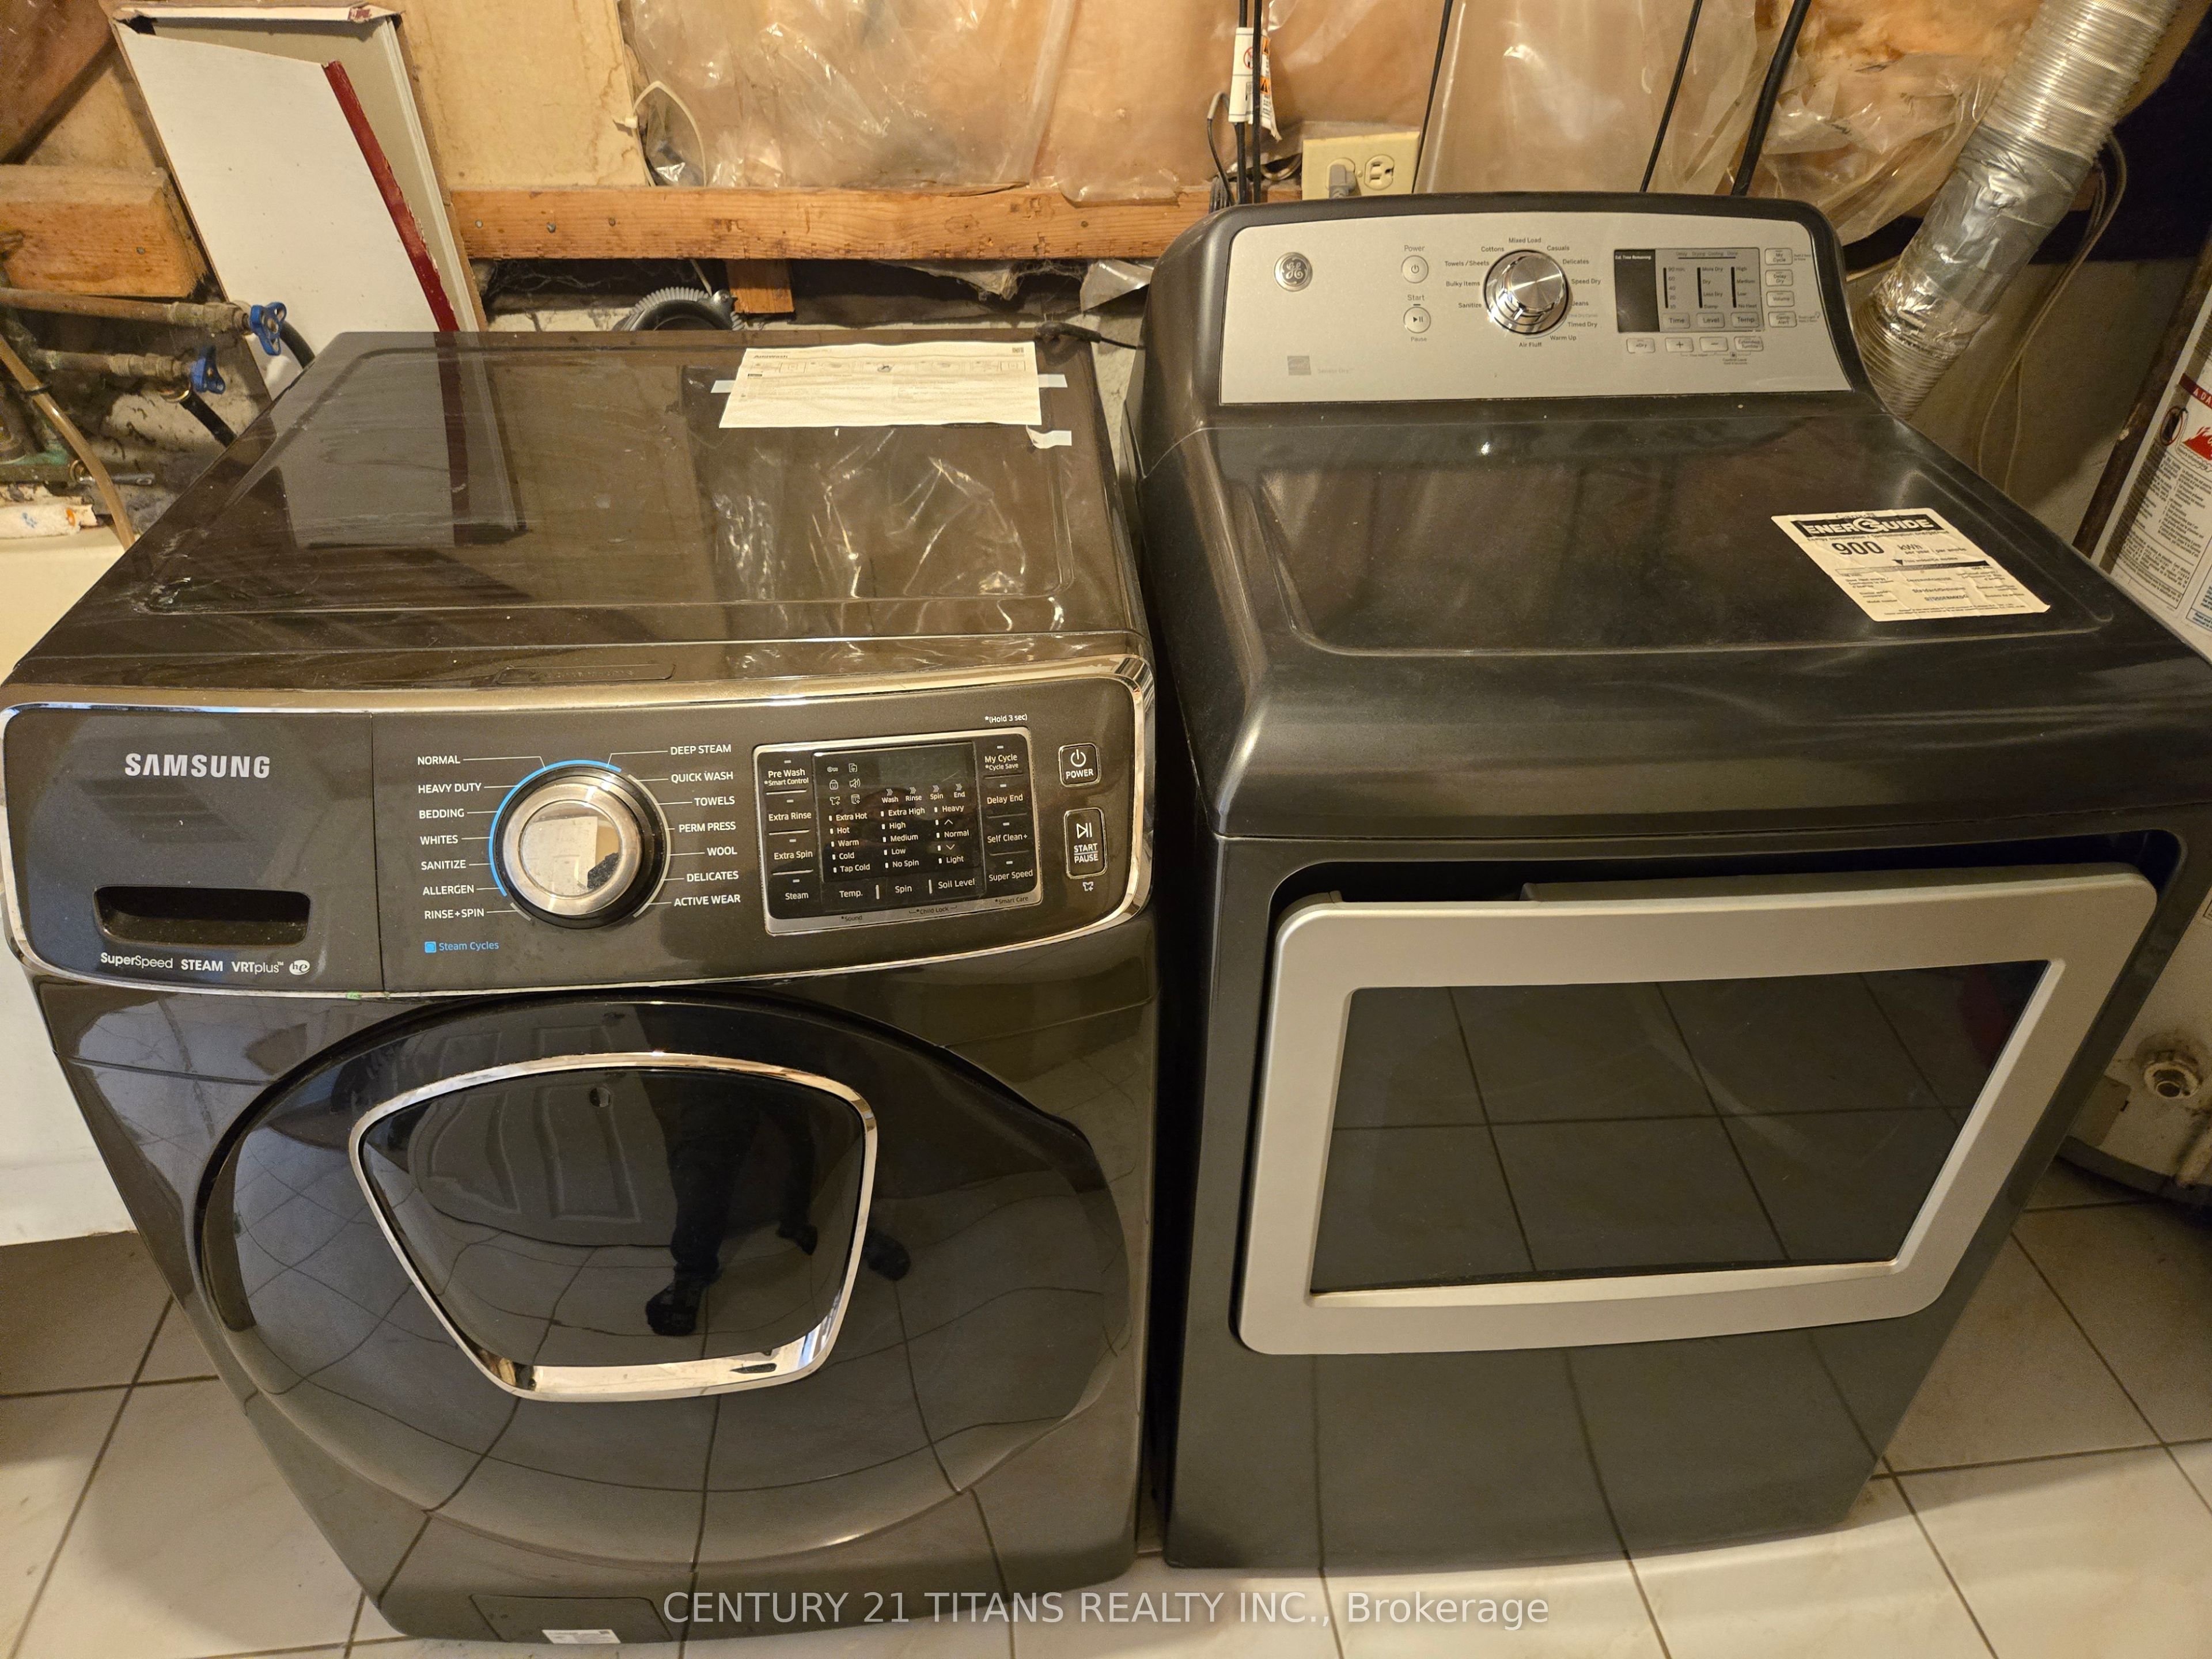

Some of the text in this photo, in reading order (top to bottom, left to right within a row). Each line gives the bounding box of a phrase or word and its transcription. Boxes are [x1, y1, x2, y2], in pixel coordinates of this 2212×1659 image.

[1804, 518, 1934, 533] ENERGUIDE
[1832, 541, 1884, 555] 900
[670, 744, 732, 756] DEEP STEAM
[417, 755, 460, 765] NORMAL
[985, 754, 1017, 764] My Cycle
[125, 753, 270, 778] SAMSUNG
[671, 771, 733, 783] QUICK WASH
[783, 768, 805, 777] Wash
[1066, 768, 1094, 779] POWER
[418, 782, 482, 794] HEAVY DUTY
[694, 796, 735, 806] TOWELS
[987, 794, 1023, 805] Delay End
[419, 809, 464, 819] BEDDING
[679, 821, 736, 832] PERM PRESS
[889, 822, 906, 830] High
[944, 830, 969, 838] Normal
[987, 835, 1001, 843] Self
[420, 835, 458, 845] WHITES
[707, 847, 737, 856] WOOL
[1074, 843, 1097, 853] START
[796, 850, 813, 859] Spin
[1074, 854, 1099, 863] PAUSE
[421, 860, 466, 870] SANITIZE
[686, 871, 739, 882] DELICATES
[989, 869, 1033, 881] Super Speed
[895, 885, 912, 893] Spin
[938, 878, 975, 889] Soil Level
[422, 884, 474, 895] ALLERGEN
[839, 890, 863, 898] Temp.
[674, 894, 741, 907] ACTIVE WEAR
[425, 908, 484, 919] RINSE+SPIN
[439, 940, 499, 952] Steam Cycles
[100, 952, 173, 969] SuperSpeed
[181, 959, 223, 972] STEAM
